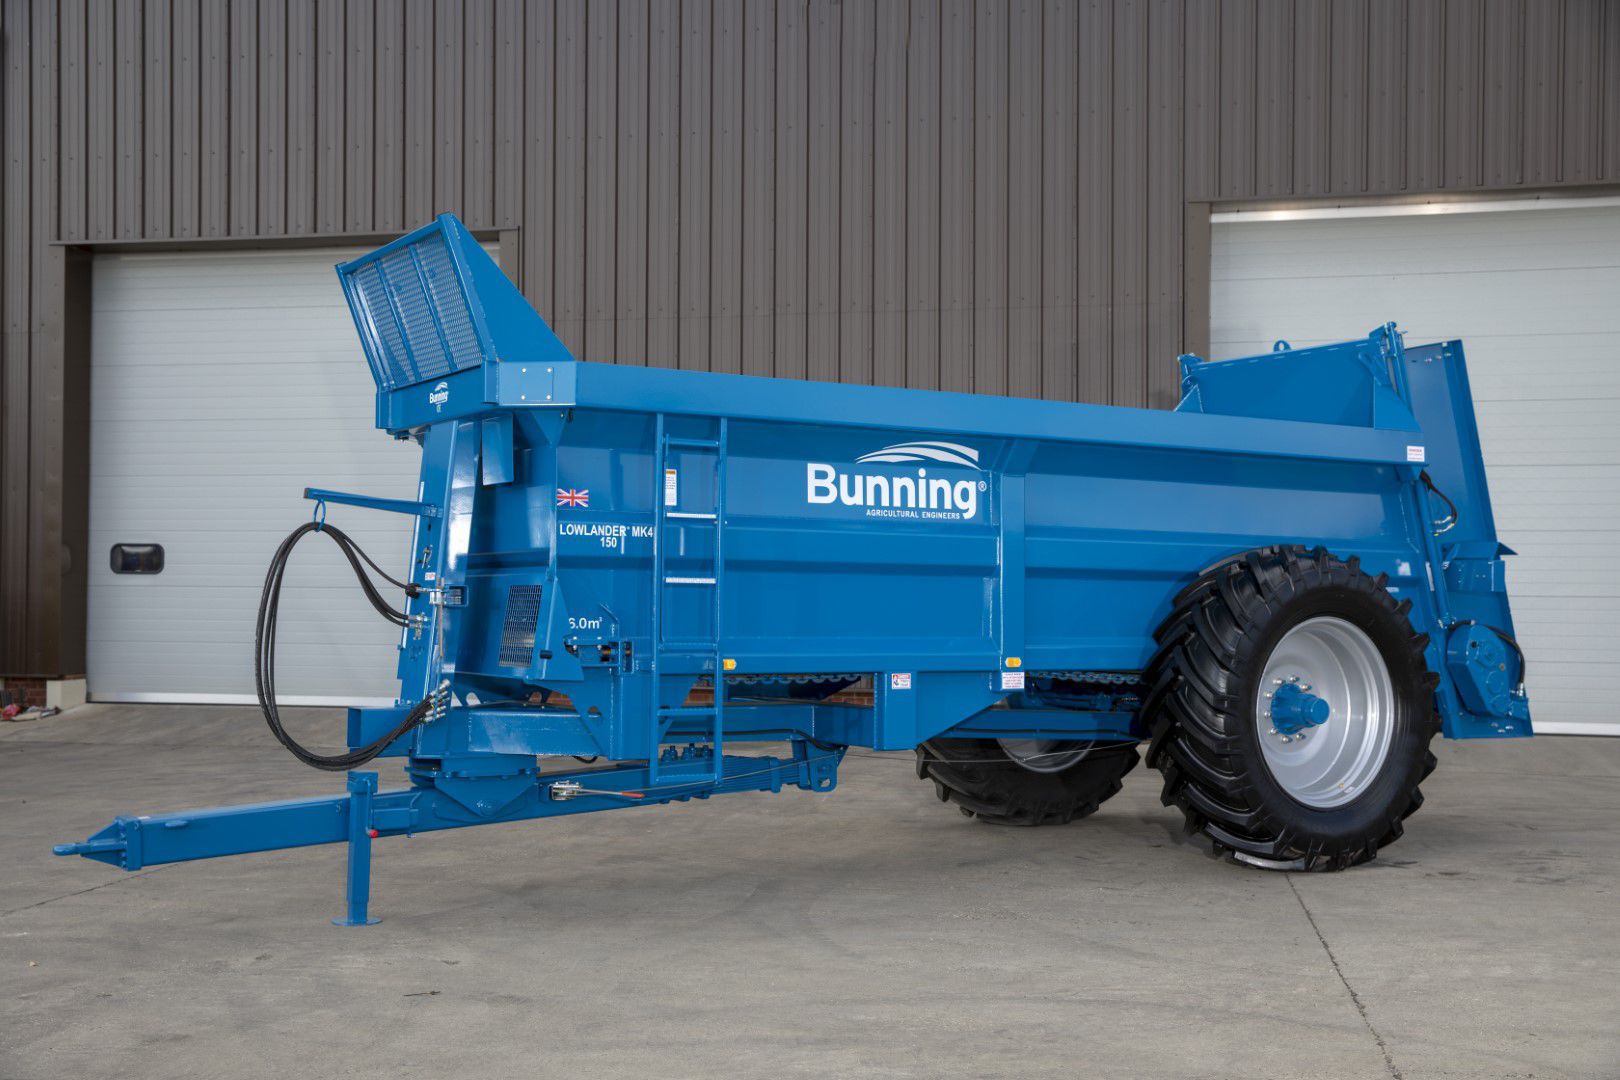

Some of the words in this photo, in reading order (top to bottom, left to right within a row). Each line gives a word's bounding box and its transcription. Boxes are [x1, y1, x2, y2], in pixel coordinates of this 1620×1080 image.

[866, 508, 919, 519] AGRICULTURAL
[922, 511, 960, 520] ENGINEERS
[631, 526, 654, 538] MK4
[600, 537, 617, 548] 150
